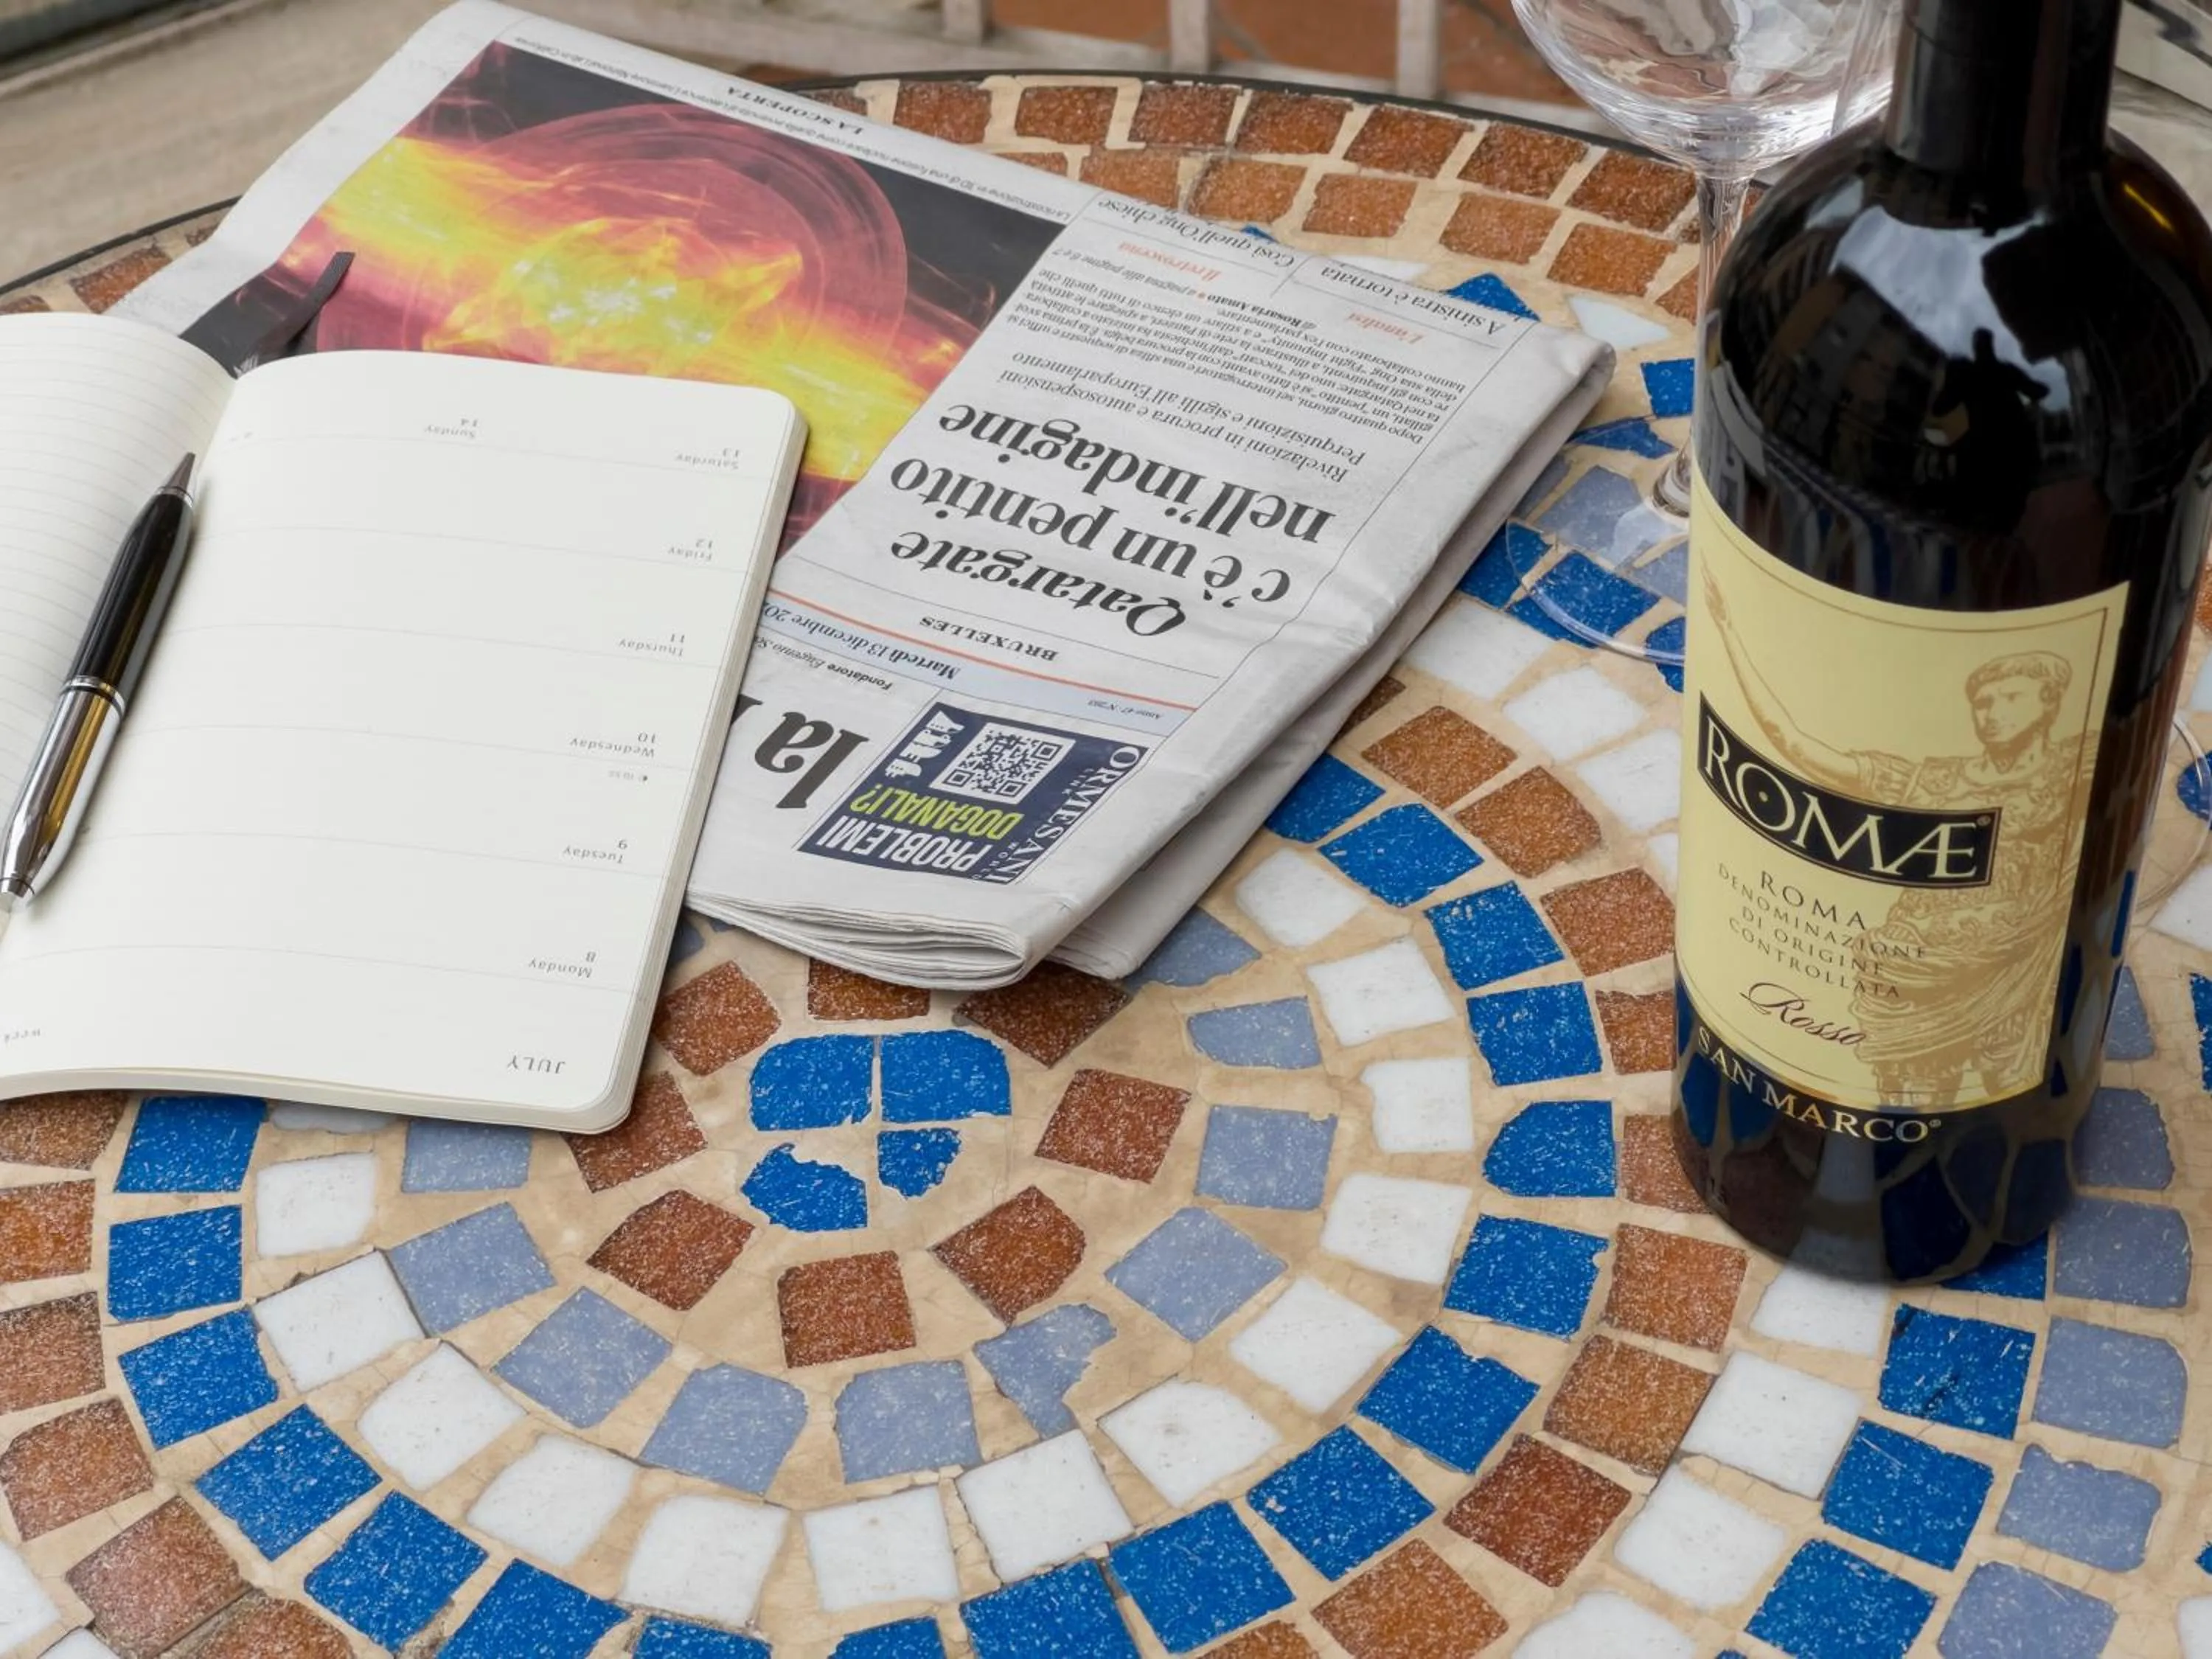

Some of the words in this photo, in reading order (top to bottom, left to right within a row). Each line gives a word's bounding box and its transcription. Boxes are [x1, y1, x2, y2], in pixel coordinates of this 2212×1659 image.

[728, 87, 833, 125] SCOPERTA
[839, 122, 863, 134] LA
[1099, 201, 1156, 223] chiese
[1157, 215, 1259, 250] quell'Ong
[1251, 246, 1294, 267] Così
[1321, 267, 1394, 297] tornata
[1394, 293, 1409, 305] è
[1411, 296, 1486, 327] sinistra
[1488, 321, 1505, 335] A
[997, 370, 1136, 412] autosospensioni
[1012, 352, 1179, 405] all'Europarlamento
[1136, 406, 1149, 417] e
[1178, 397, 1231, 420] sigilli
[1231, 413, 1244, 422] e
[424, 424, 476, 438] Sunday
[1152, 410, 1225, 438] procura
[1225, 432, 1245, 448] in
[1242, 417, 1366, 465] Perquisizioni
[674, 453, 739, 469] Saturday
[939, 405, 1336, 543] nell'indagine
[1244, 439, 1349, 482] Rivelazioni
[891, 459, 1119, 551] pentito
[667, 547, 712, 560] Friday
[695, 538, 712, 548] 12
[1112, 527, 1197, 578] un
[891, 532, 1186, 636] Qatargate
[1203, 555, 1290, 608] c'è
[669, 634, 684, 643] 11
[791, 615, 869, 649] dicembre
[920, 617, 1058, 661] BRUXELLES
[618, 639, 683, 656] Thursday
[867, 643, 889, 657] 13
[827, 664, 893, 690] Fondatore
[888, 649, 960, 680] Martedì
[569, 737, 654, 758] Wednesday
[637, 732, 655, 743] 10
[754, 712, 869, 808] la
[850, 784, 1025, 840] DOGANALI?
[562, 845, 622, 863] Tuesday
[616, 839, 627, 849] 9
[816, 815, 990, 872] PROBLEMI
[1719, 863, 1926, 959] DENOMINAZIONE
[1761, 870, 1865, 931] ROMA
[1742, 905, 1762, 929] DI
[1774, 928, 1881, 976] ORIGINE
[527, 957, 592, 978] Monday
[585, 951, 596, 961] 8
[1729, 917, 1900, 998] CONTROLLATA
[1739, 981, 1866, 1046] Rosso
[506, 1054, 565, 1074] JULY
[1698, 1026, 1756, 1095] SAN
[1762, 1080, 1930, 1143] MARCO
